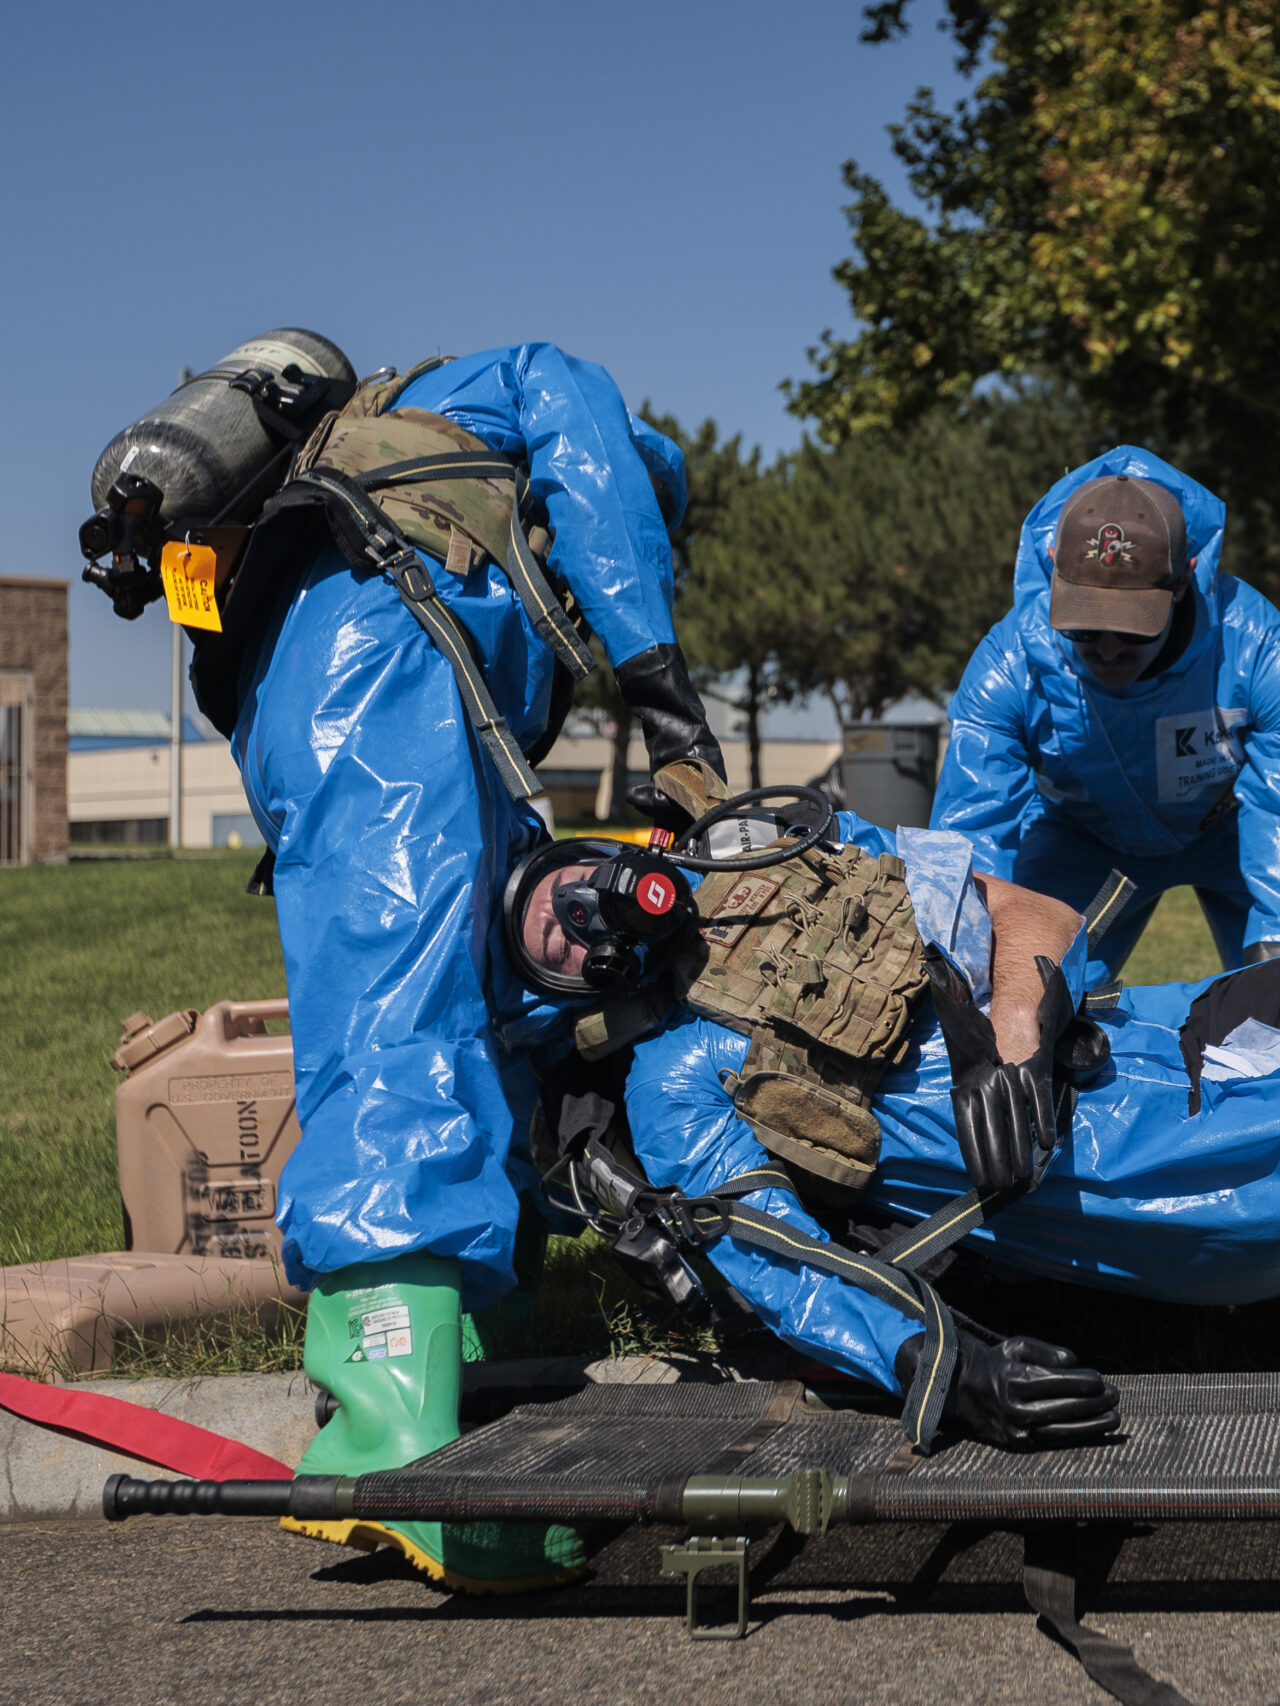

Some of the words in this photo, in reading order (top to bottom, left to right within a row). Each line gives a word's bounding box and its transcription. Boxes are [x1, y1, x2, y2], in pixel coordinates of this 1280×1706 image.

[1178, 767, 1216, 787] TRAINING
[1217, 766, 1236, 775] USE
[738, 817, 752, 853] AIR-PA
[183, 1077, 250, 1091] PROPERTY
[261, 1074, 278, 1086] OF
[203, 1088, 291, 1102] GOVERNMENT
